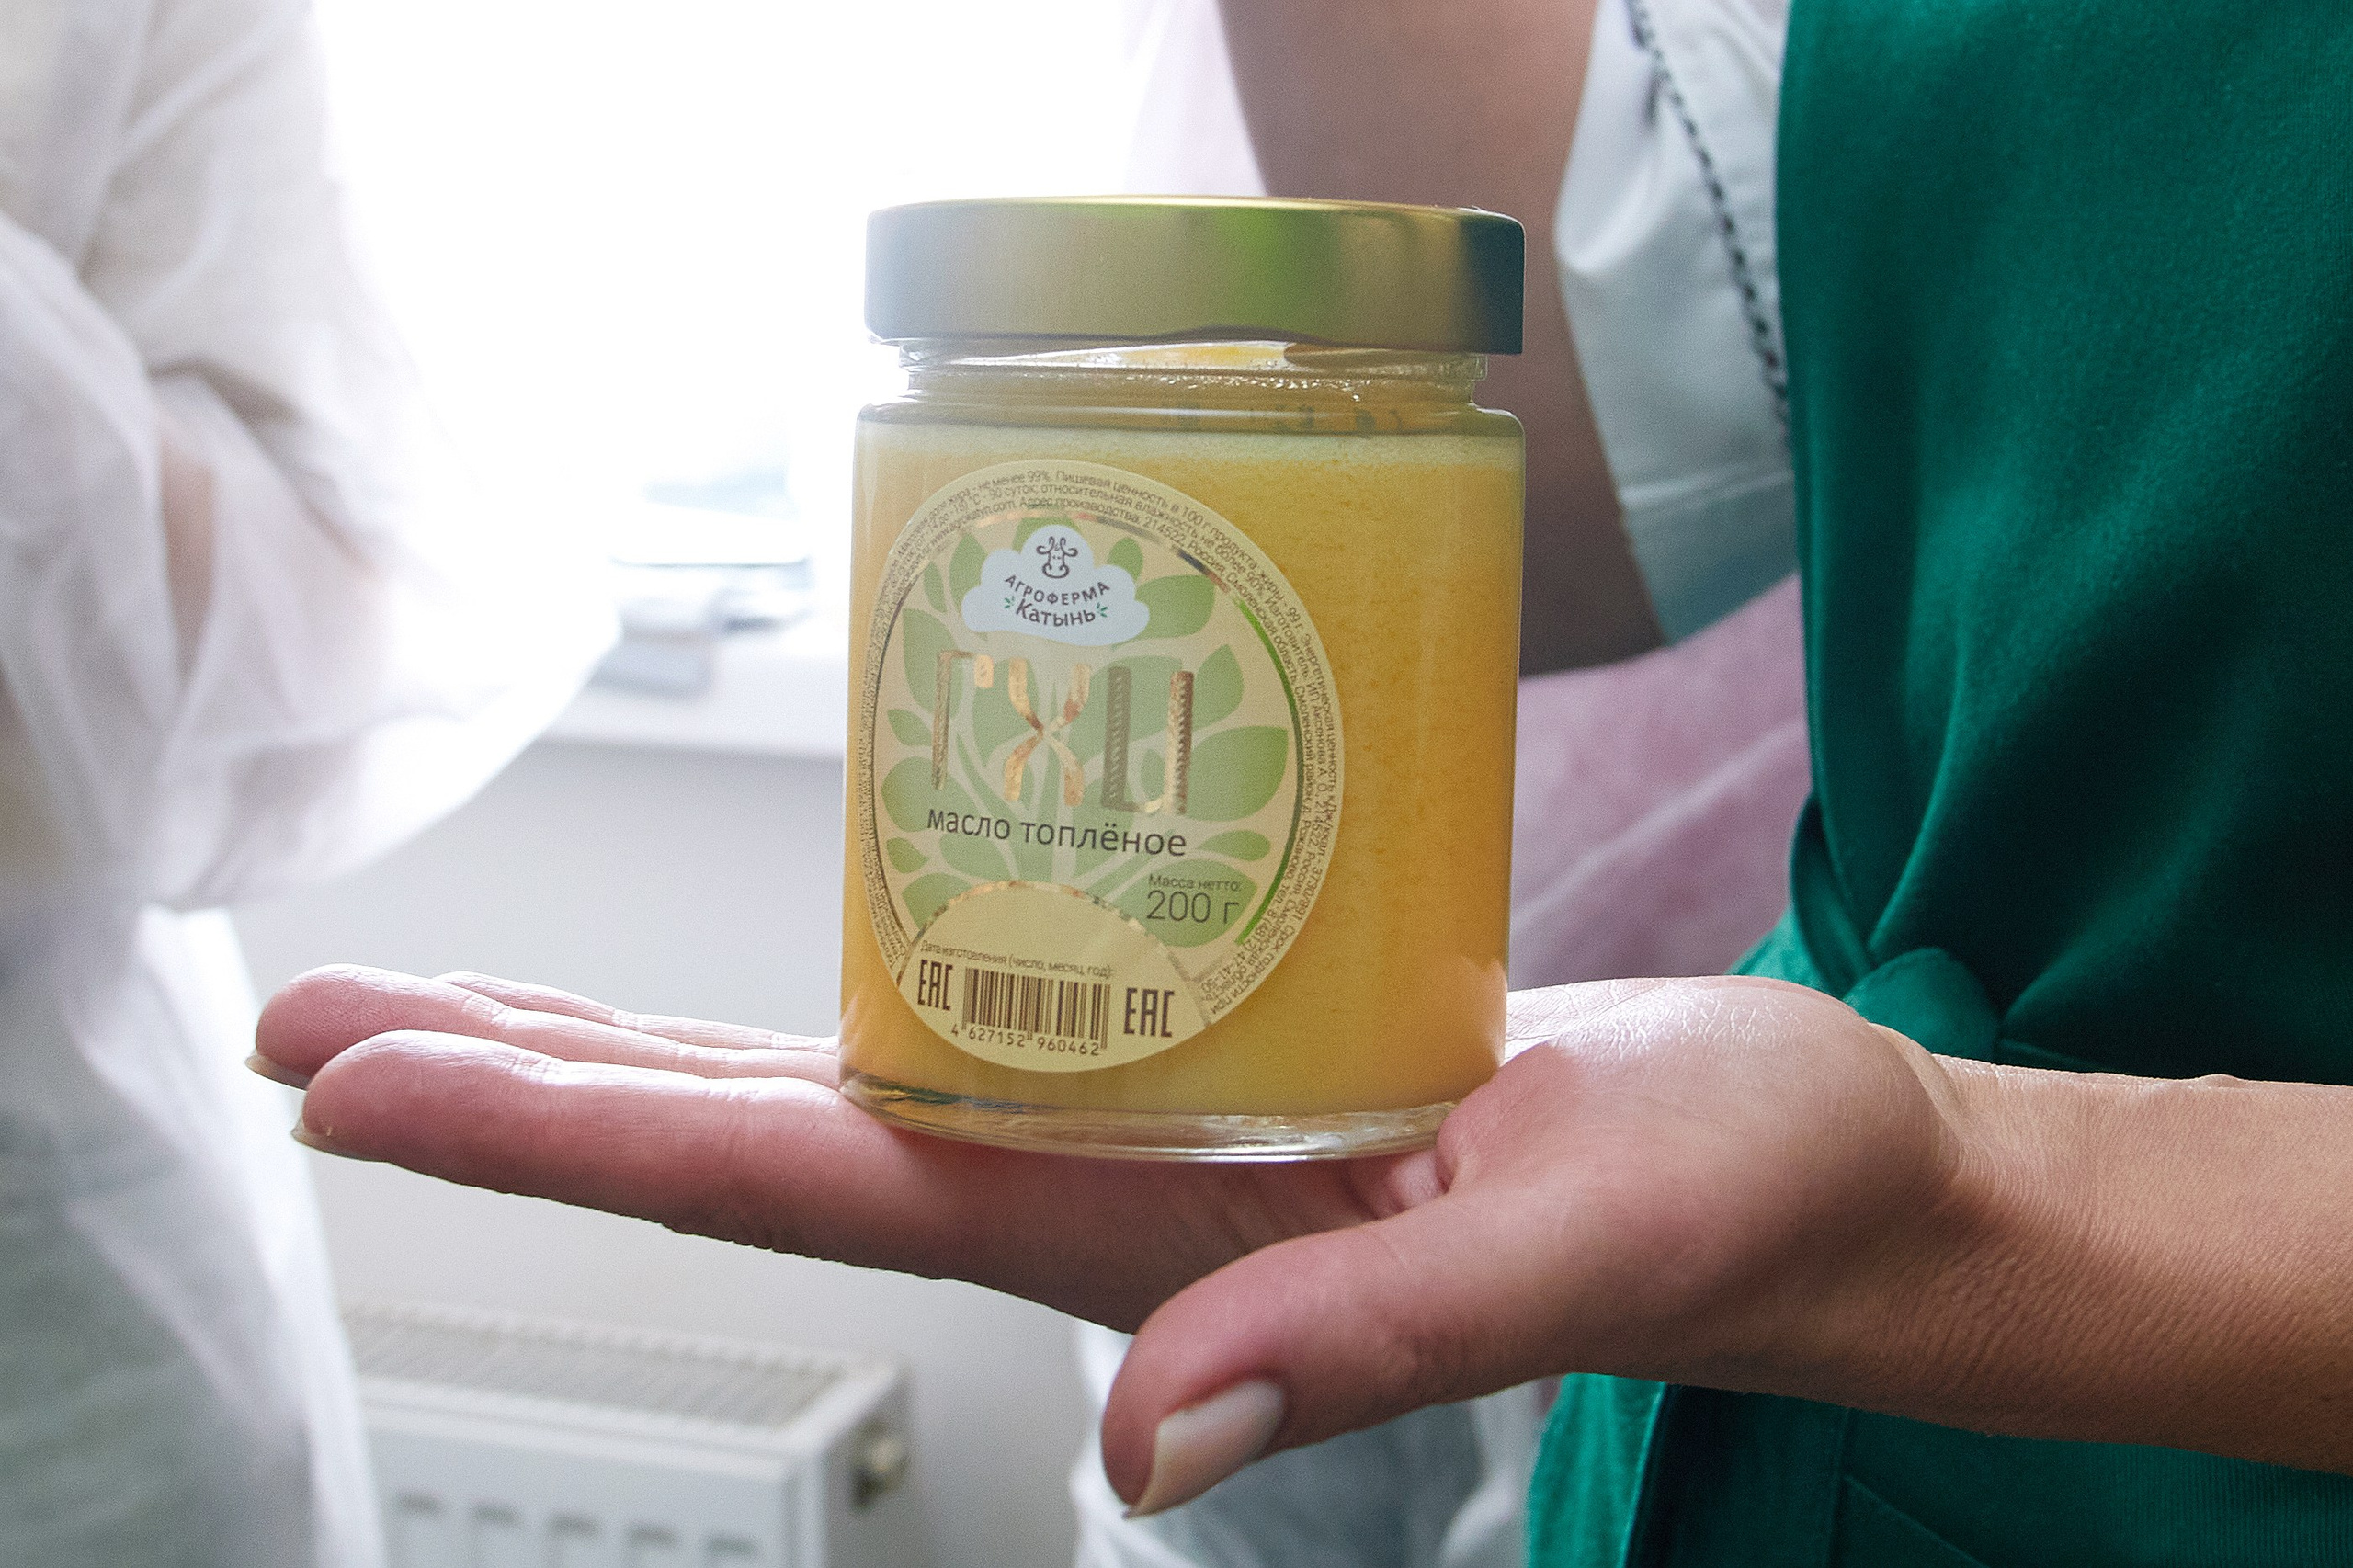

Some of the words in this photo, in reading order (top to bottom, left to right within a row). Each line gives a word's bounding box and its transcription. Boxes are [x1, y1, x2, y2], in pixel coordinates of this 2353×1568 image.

[1056, 470, 1111, 488] Пищевая
[1041, 483, 1132, 507] относительная
[1112, 480, 1170, 509] ценность
[1133, 499, 1199, 540] влажность
[1180, 506, 1204, 527] 100
[1199, 534, 1215, 549] не
[1213, 543, 1247, 574] более
[1005, 574, 1110, 606] АГРОФЕРМА
[1255, 569, 1284, 602] жиры
[1016, 598, 1096, 627] Катынь
[1224, 570, 1280, 635] Смоленская
[1284, 606, 1302, 623] 99
[1299, 632, 1337, 730] Энергетическая
[1306, 681, 1321, 701] ИП
[1293, 685, 1316, 760] Смоленский
[927, 809, 1010, 839] масло
[1020, 821, 1187, 856] топлёное
[1149, 874, 1193, 889] Масса
[1147, 890, 1211, 923] 200
[1266, 908, 1278, 918] 8
[1245, 898, 1296, 967] Смоленская
[1269, 923, 1296, 953] Срок
[1229, 950, 1275, 997] годности
[1207, 992, 1232, 1014] при
[950, 1023, 959, 1037] 4
[969, 1028, 1026, 1048] 627152
[1037, 1036, 1100, 1056] 960462
